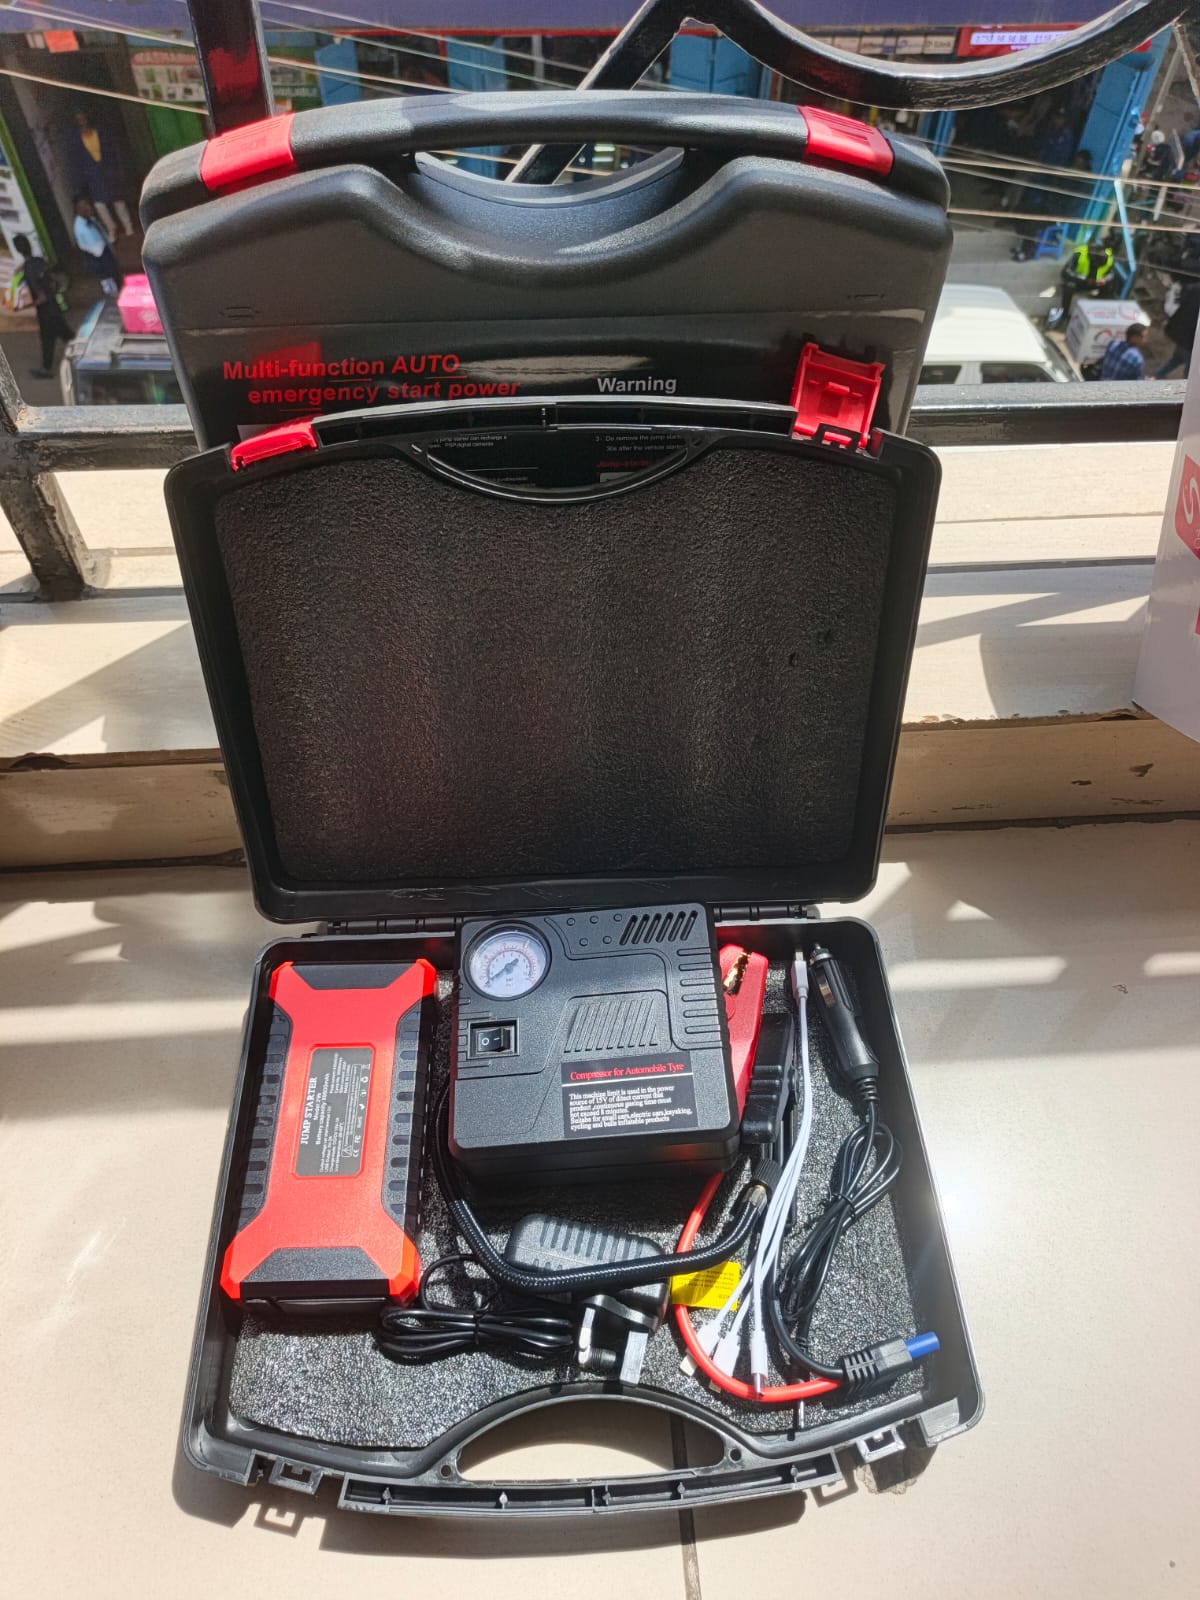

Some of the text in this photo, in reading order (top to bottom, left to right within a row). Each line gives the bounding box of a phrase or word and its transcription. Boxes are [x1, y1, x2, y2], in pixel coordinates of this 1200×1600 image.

[223, 354, 461, 380] Multi-function AUTO
[248, 379, 521, 405] emergency start power
[597, 376, 677, 394] Warning
[570, 1062, 684, 1081] Compressor for Automobile Tyre
[300, 1077, 317, 1145] JUMP STARTER
[571, 1123, 591, 1132] cycling
[618, 1118, 644, 1126] inflatable
[646, 1116, 670, 1124] products
